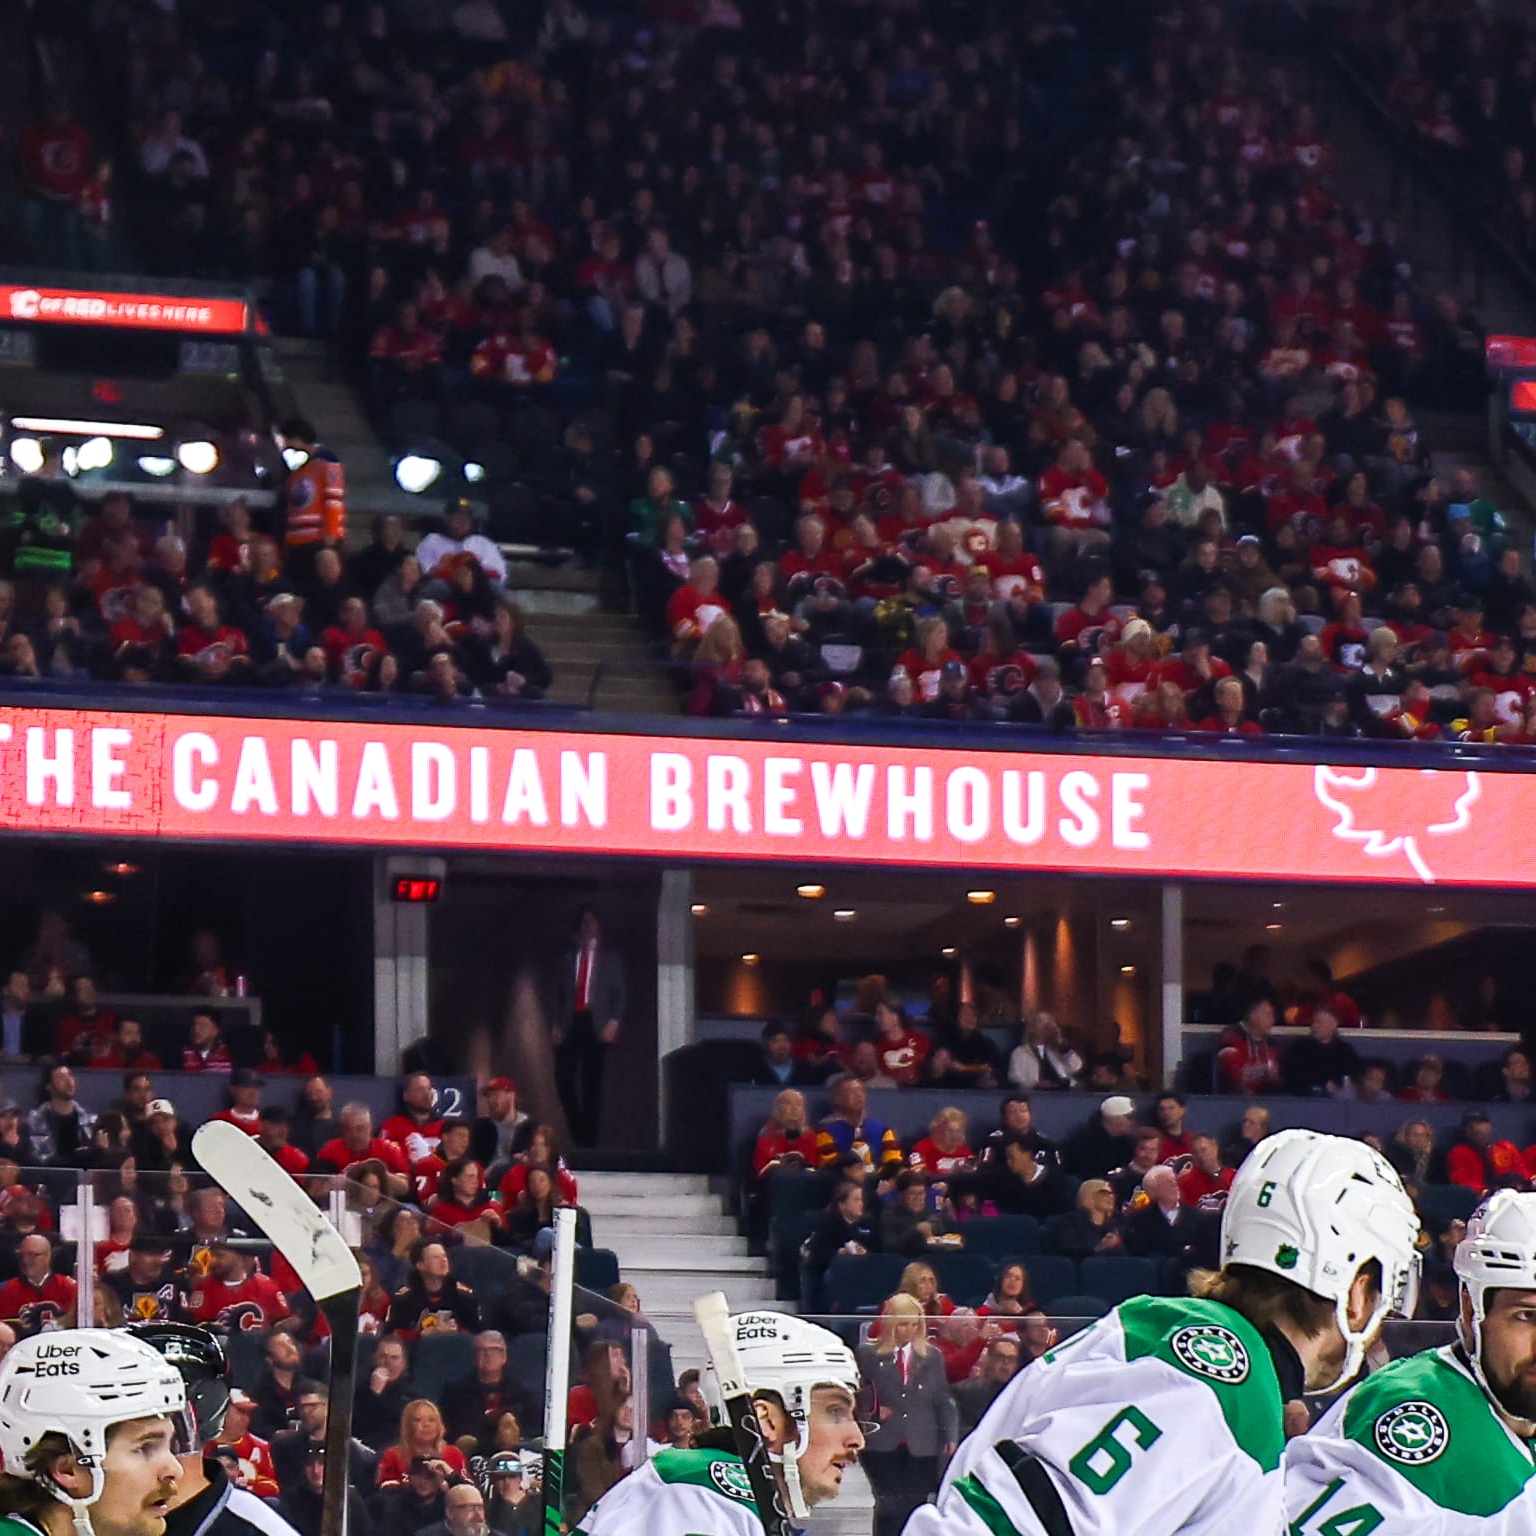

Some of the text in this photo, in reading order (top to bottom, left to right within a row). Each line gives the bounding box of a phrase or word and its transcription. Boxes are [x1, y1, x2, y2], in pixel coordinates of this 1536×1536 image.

[172, 732, 607, 828] CANADIAN
[648, 751, 1152, 851] BREWHOUSE
[1257, 1181, 1276, 1207] 6
[738, 1316, 778, 1326] Uber
[736, 1326, 777, 1341] Eats
[36, 1345, 83, 1358] Uber
[35, 1361, 80, 1378] Eats
[1069, 1404, 1164, 1495] 6
